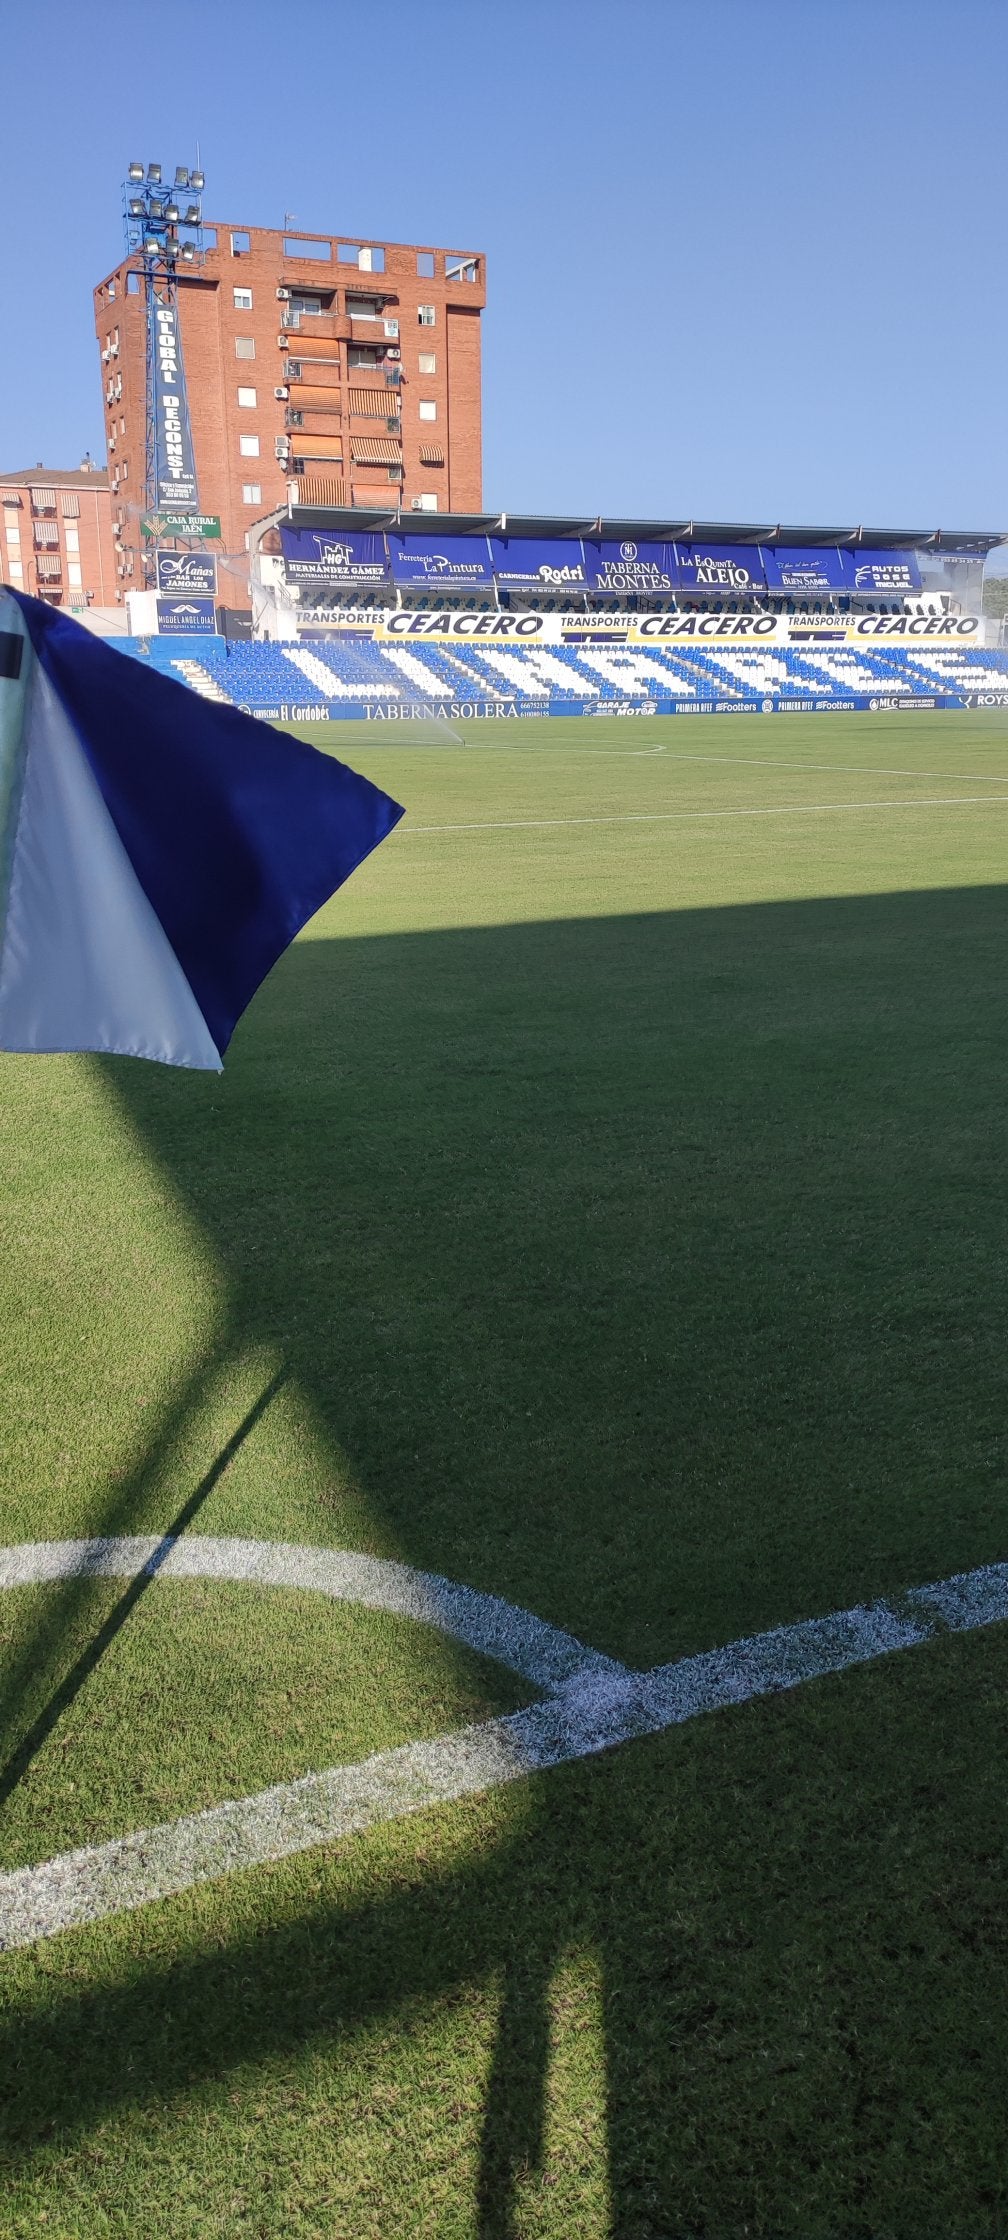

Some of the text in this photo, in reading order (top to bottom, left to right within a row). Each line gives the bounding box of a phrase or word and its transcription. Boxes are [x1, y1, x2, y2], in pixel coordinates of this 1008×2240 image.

[157, 310, 178, 383] GLOBAL
[163, 395, 184, 479] DECONST
[166, 516, 216, 526] CAJA RURAL
[327, 554, 342, 564] HG
[681, 556, 693, 566] LA
[289, 562, 349, 575] HERNÁNDEZ
[351, 566, 385, 575] GÁMEZ
[602, 562, 660, 574] TABERNA
[539, 565, 585, 584] Rodri
[696, 568, 750, 587] ALEJO
[781, 575, 803, 585] BUEN
[803, 576, 831, 586] SABOR
[166, 580, 208, 588] JAMONES
[596, 574, 671, 589] MONTES
[158, 615, 180, 624] MIGUEL
[296, 612, 385, 624] TRANSPORTES
[387, 613, 544, 636] CEACERO
[788, 616, 979, 635] TRANSPORTES CEACERO
[561, 617, 638, 627] TRANSPORTES
[640, 616, 777, 636] CEACERO
[596, 701, 631, 709] GARAJE
[676, 703, 700, 713] PRIMERA
[778, 701, 801, 711] PRIMERA
[879, 697, 899, 708] MLC
[280, 704, 289, 721] El
[291, 704, 330, 721] Cordobés
[363, 702, 519, 720] TABERNA SOLERA
[616, 708, 656, 716] MOTOR
